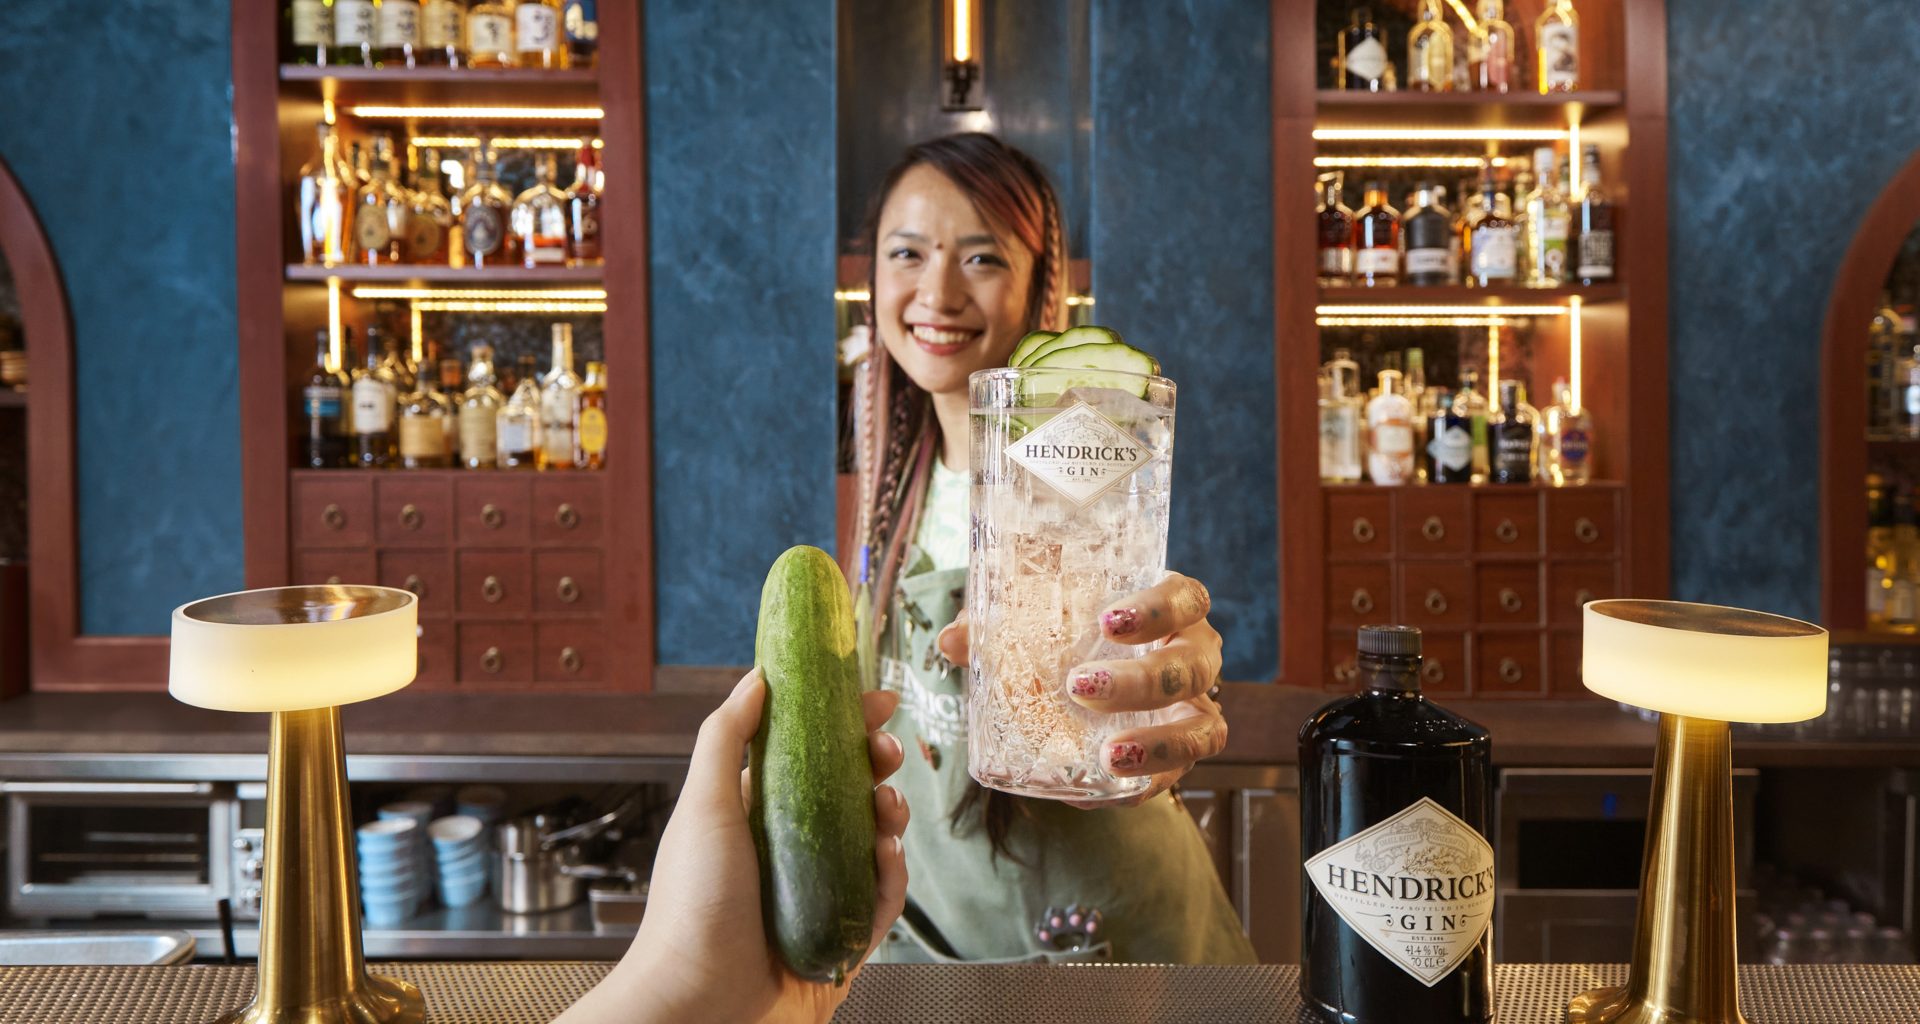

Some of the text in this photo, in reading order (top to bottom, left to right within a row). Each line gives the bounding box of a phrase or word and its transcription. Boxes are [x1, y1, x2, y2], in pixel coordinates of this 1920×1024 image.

[1026, 445, 1137, 462] HENDRICK'S
[1066, 466, 1099, 476] GIN
[1327, 864, 1494, 902] HENDRICK'S
[1400, 914, 1456, 931] GIN
